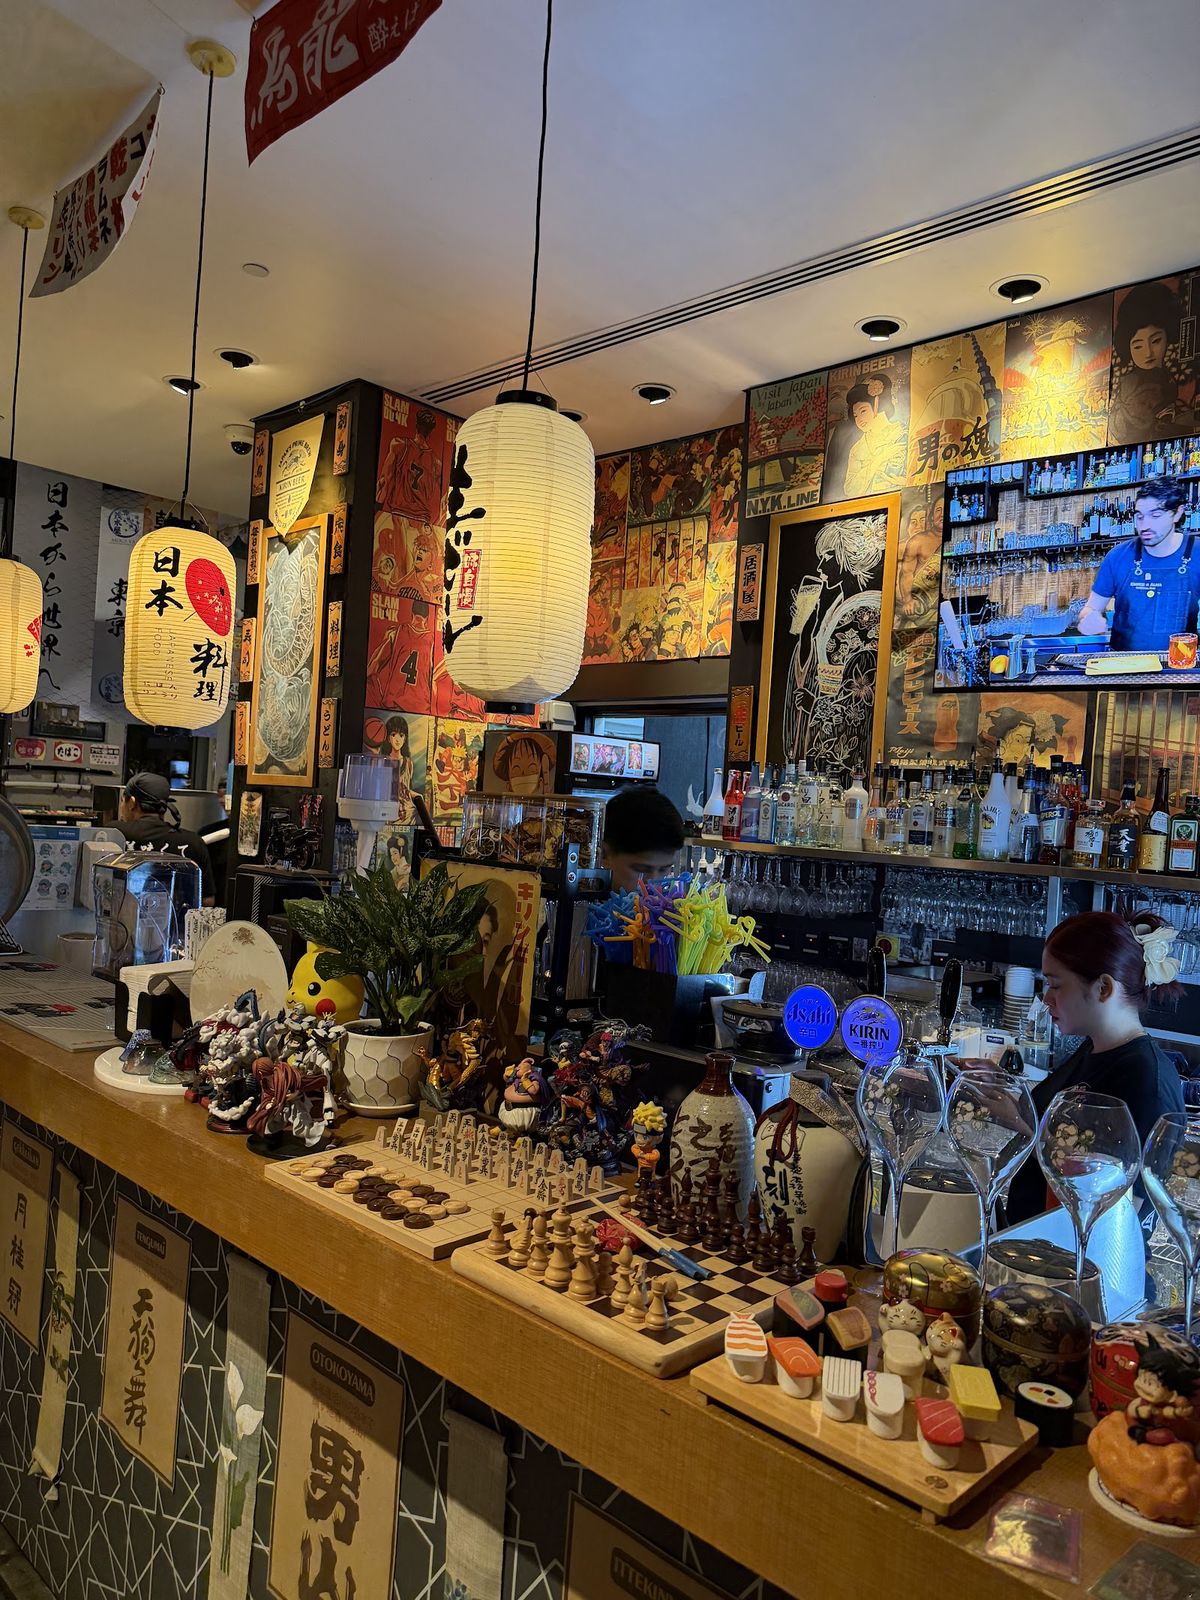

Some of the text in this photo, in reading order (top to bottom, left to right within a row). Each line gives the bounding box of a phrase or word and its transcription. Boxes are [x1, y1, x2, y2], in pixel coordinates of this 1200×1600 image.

[830, 354, 896, 383] KIRIN BEER
[384, 393, 410, 415] SLAM
[755, 386, 782, 405] Visit
[911, 416, 994, 477] 男の魂
[410, 462, 424, 490] 7
[39, 481, 69, 691] 日本から世界へ
[145, 546, 184, 617] 日本
[741, 555, 758, 605] 居酒屋
[371, 592, 400, 611] SLAM
[152, 627, 163, 656] FOOD
[328, 618, 341, 661] 料理
[190, 637, 229, 706] 料理
[400, 650, 418, 686] 4
[237, 711, 246, 753] ラーメン
[321, 710, 332, 752] うどん
[57, 746, 79, 758] たばこ
[786, 1001, 833, 1026] Asahi
[798, 1025, 818, 1039] 辛口
[849, 1023, 891, 1041] KIRIN
[853, 1039, 885, 1050] 一番搾り
[8, 1192, 28, 1317] 月桂冠
[312, 1347, 375, 1403] OTOKOYAMA
